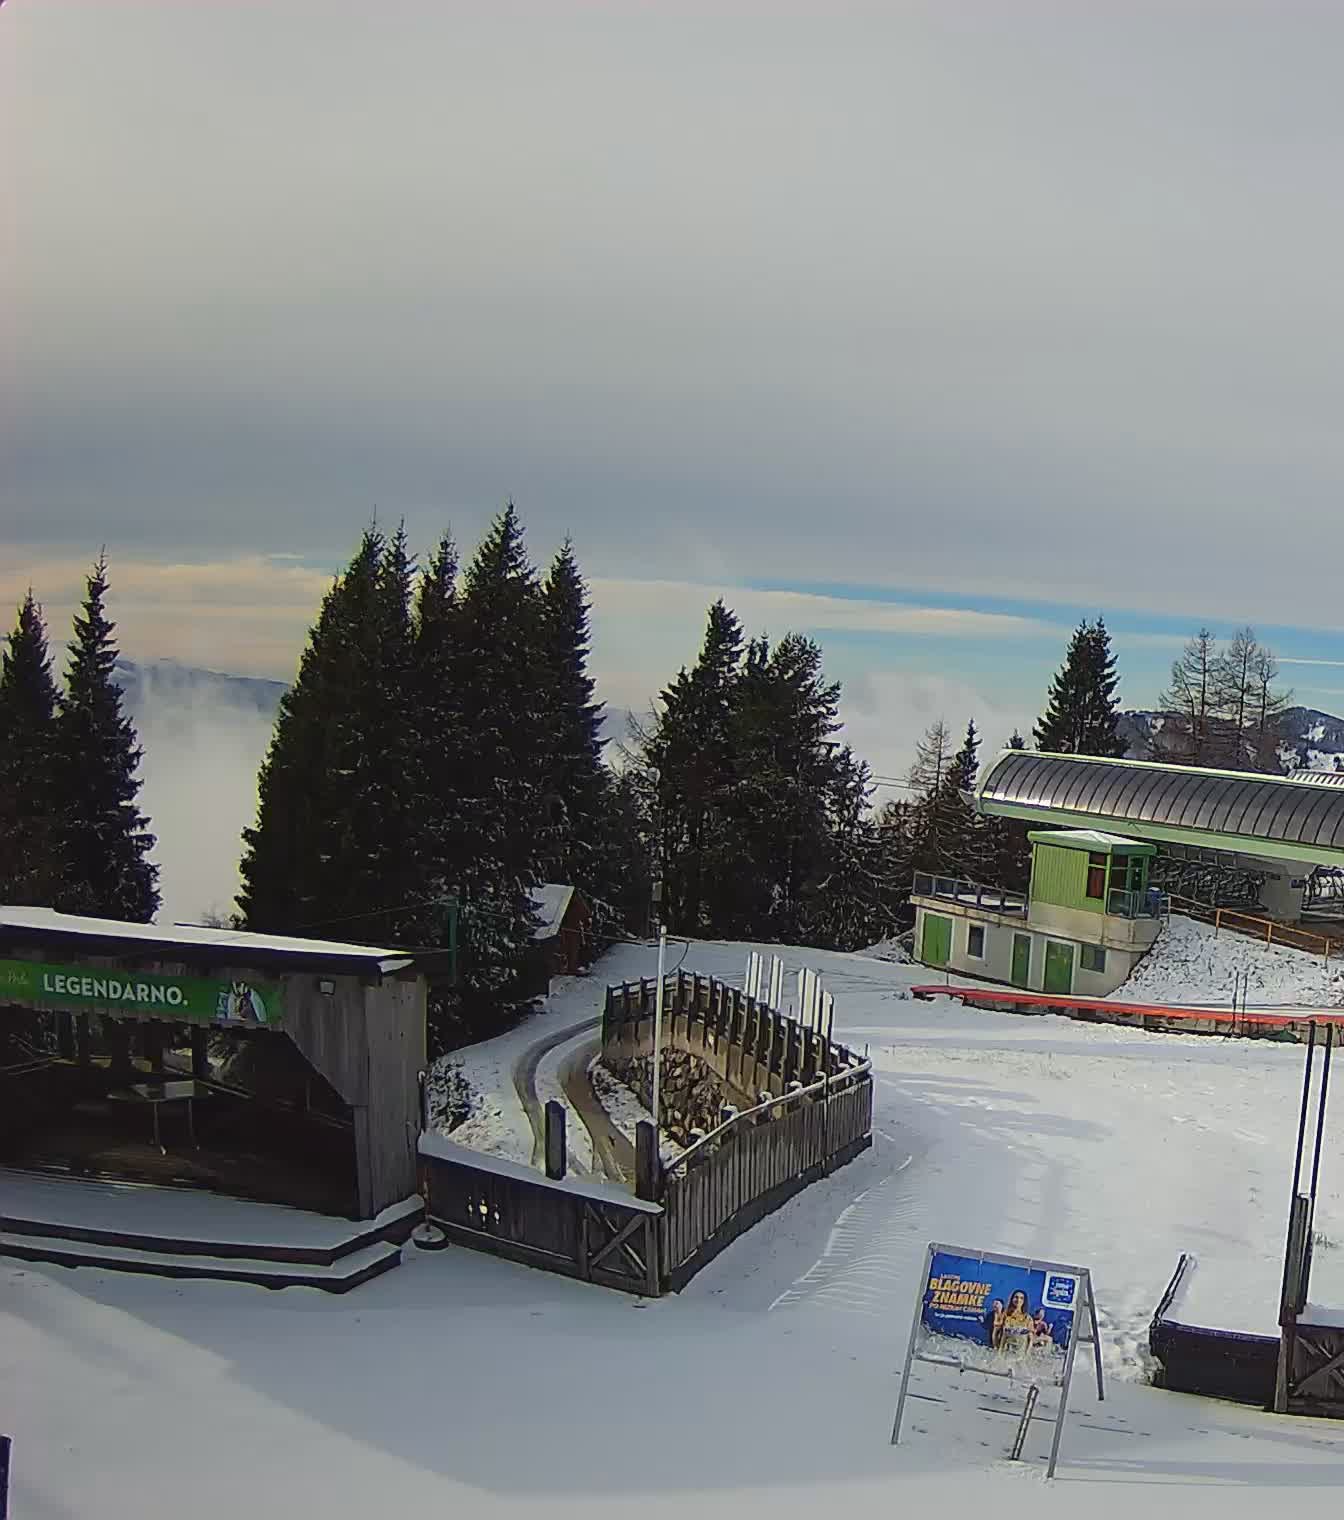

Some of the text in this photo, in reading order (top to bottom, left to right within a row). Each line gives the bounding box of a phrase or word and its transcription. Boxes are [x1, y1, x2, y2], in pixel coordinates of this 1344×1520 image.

[43, 972, 188, 1006] LEGENDARNO.
[929, 1277, 992, 1295] BLAGOVNE
[932, 1291, 985, 1307] ZNAMKE
